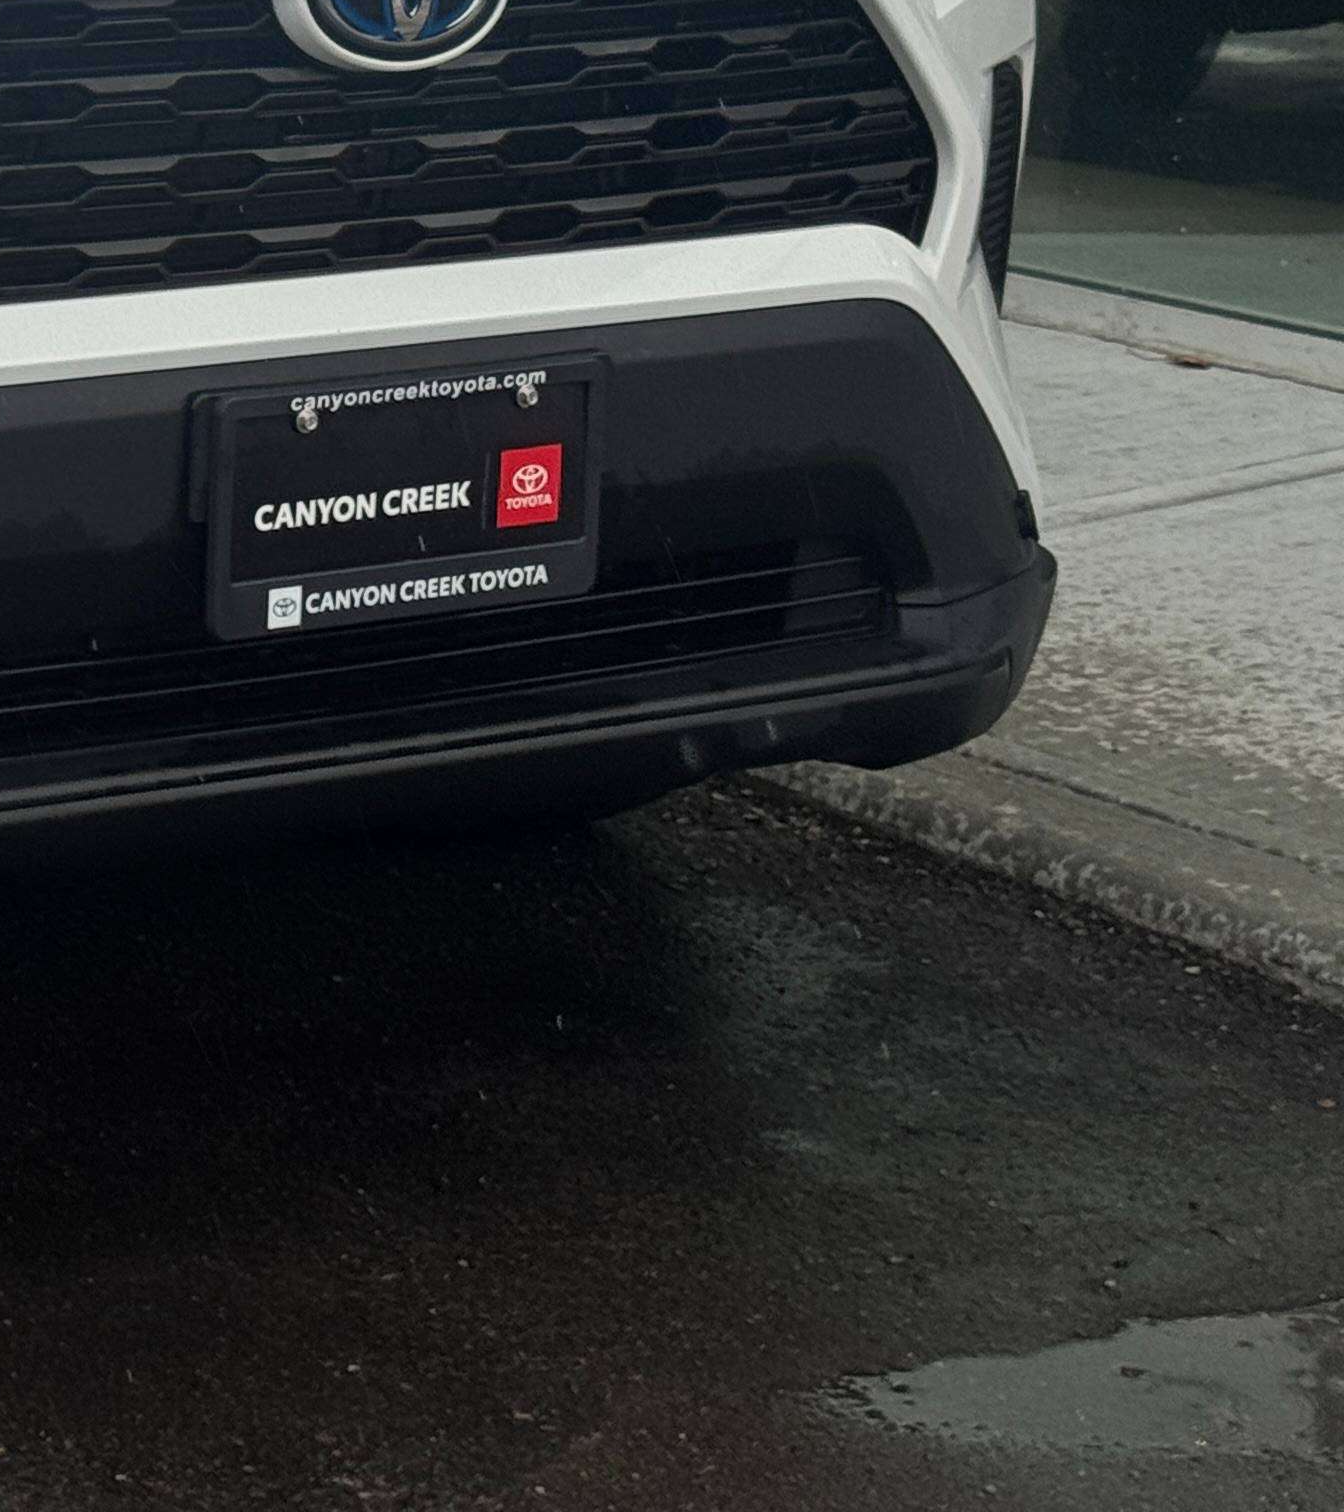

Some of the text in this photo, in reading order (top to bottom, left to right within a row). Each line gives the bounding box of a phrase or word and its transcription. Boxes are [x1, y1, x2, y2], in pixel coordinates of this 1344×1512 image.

[290, 371, 547, 412] canyoncreektoyota.com
[254, 481, 472, 533] CANYON CREEK
[505, 493, 553, 511] TOYOTA
[305, 564, 549, 615] CANYON CREEK TOYOTA
